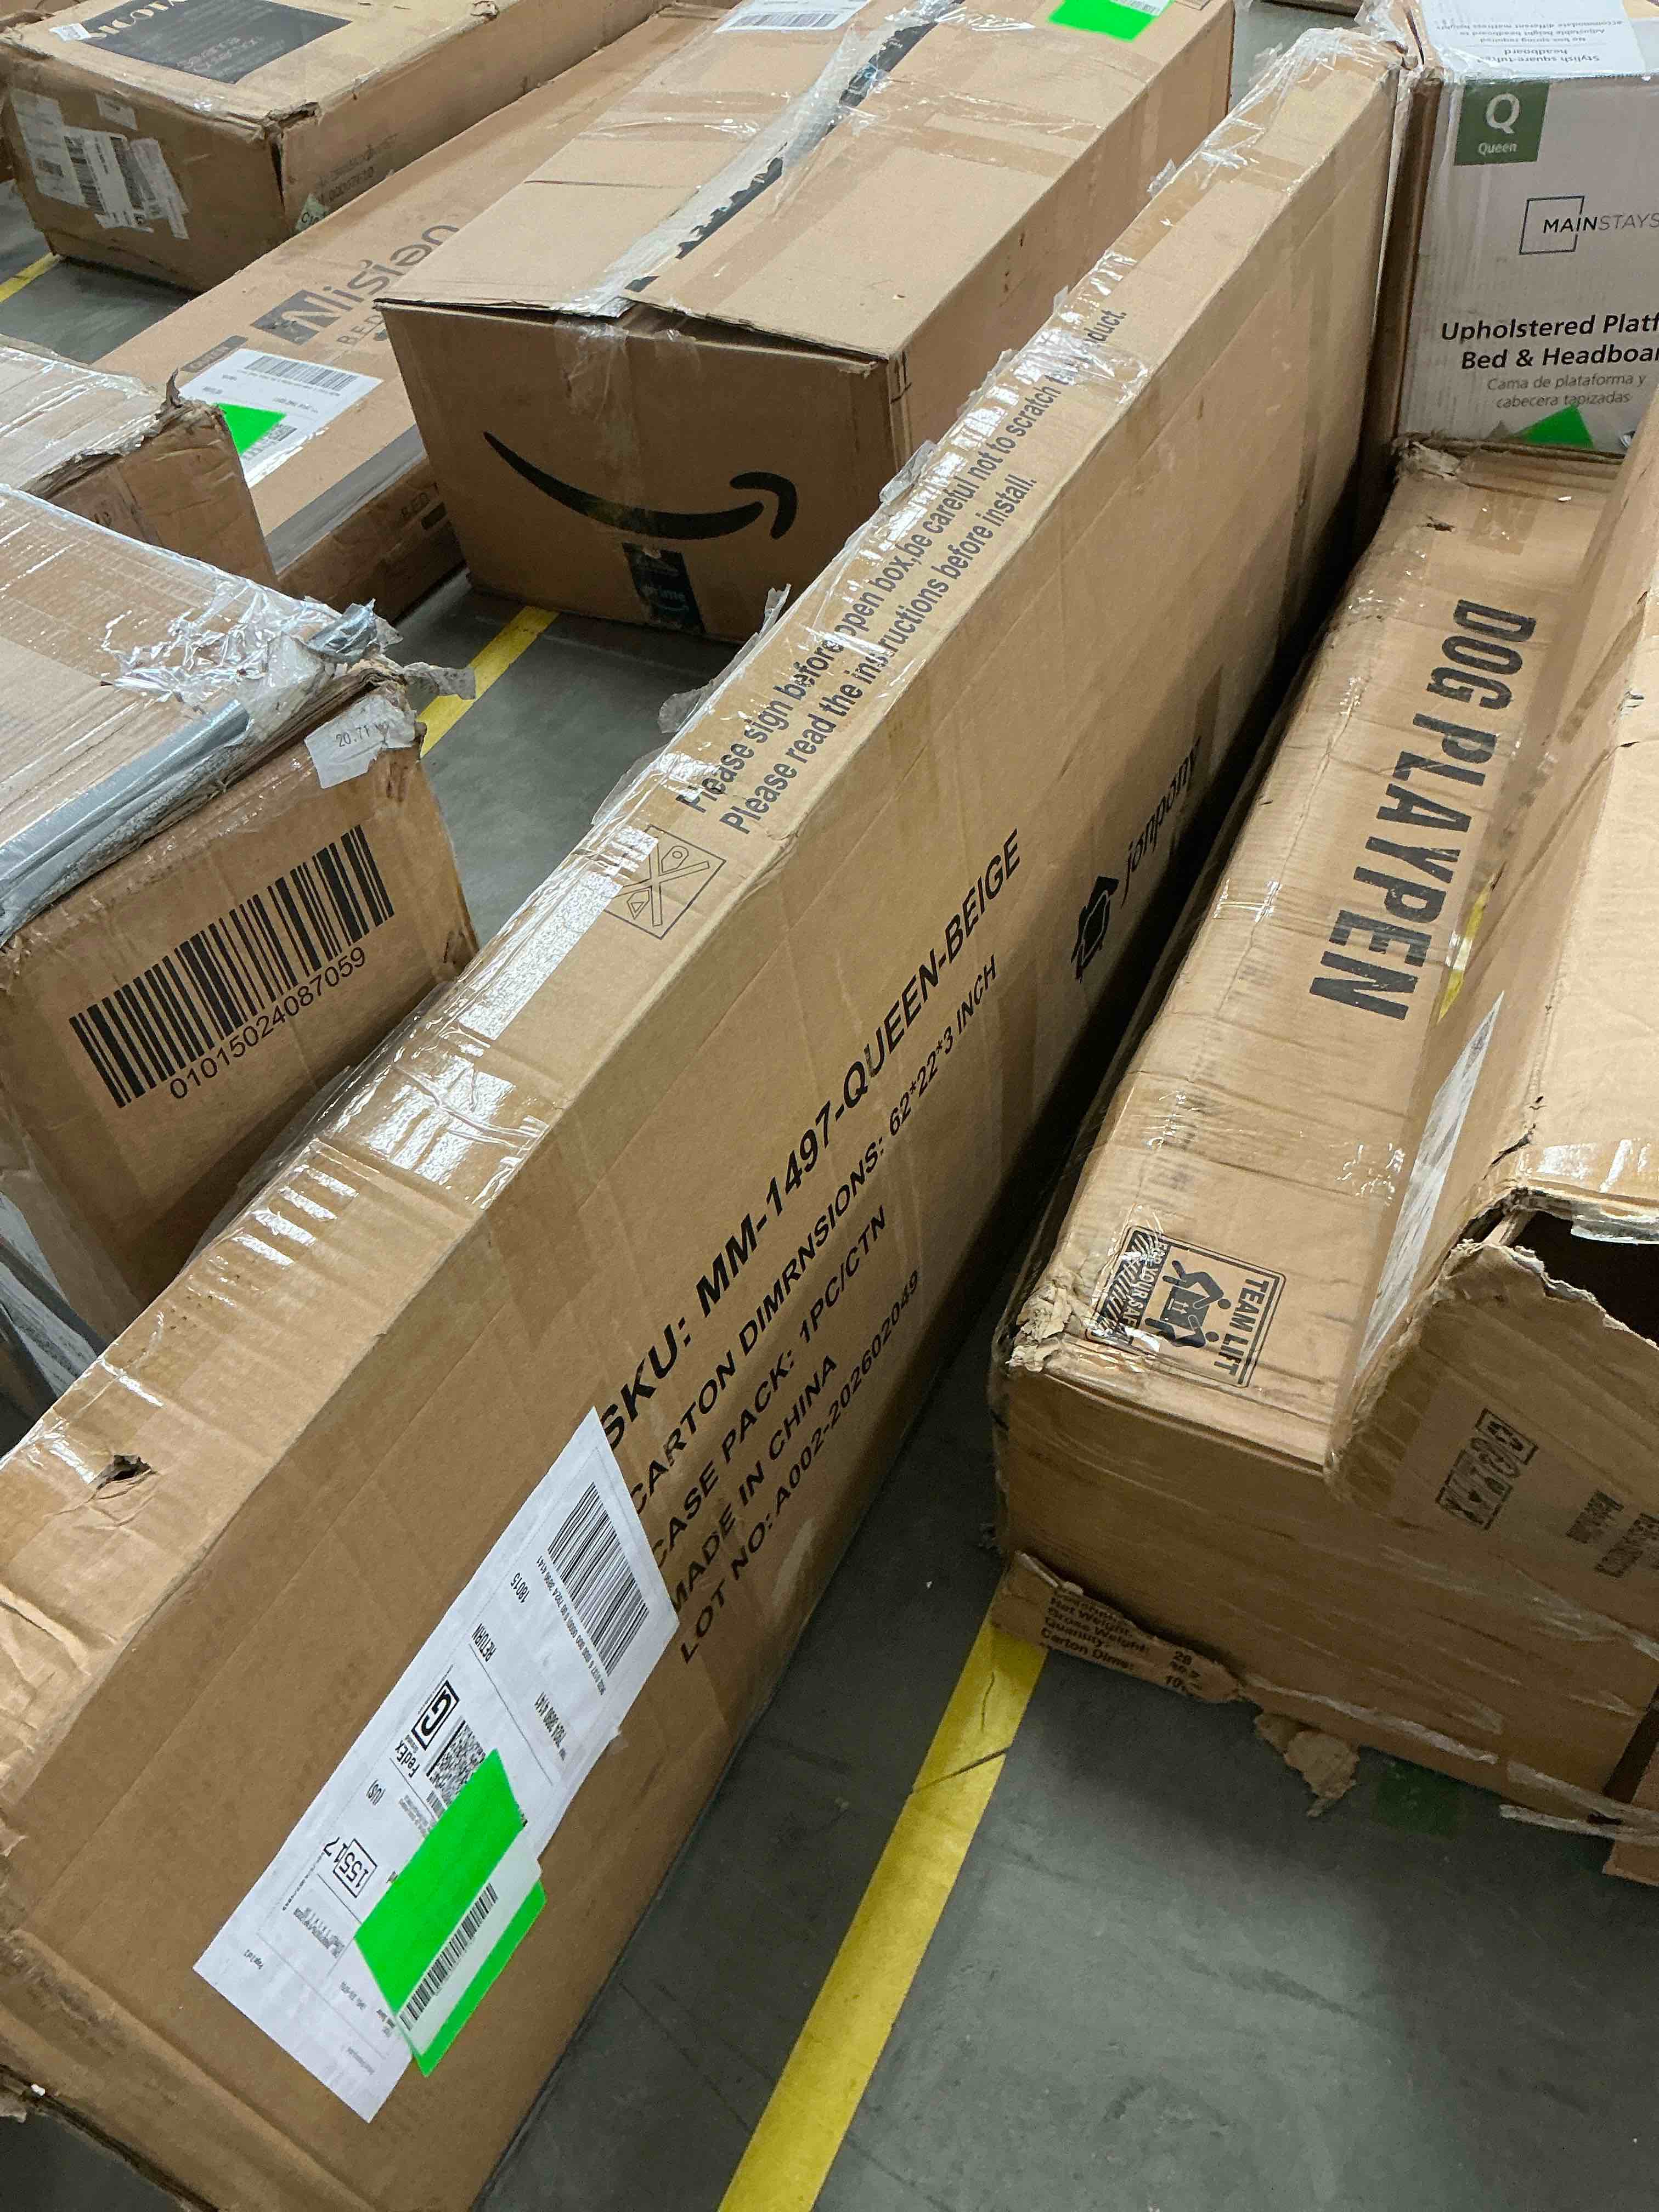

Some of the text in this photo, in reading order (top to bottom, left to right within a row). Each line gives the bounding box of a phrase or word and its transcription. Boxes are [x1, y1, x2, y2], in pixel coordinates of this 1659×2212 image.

[1486, 93, 1520, 134] Q
[1477, 142, 1518, 156] Queen
[1543, 212, 1659, 234] MAINSTAYS
[1441, 315, 1595, 344] Upholstered
[1462, 349, 1508, 369] Bed
[1516, 349, 1533, 367] &
[1488, 373, 1646, 395] Cama de plataforma y
[1496, 391, 1631, 409] cabecera tapizadas
[675, 743, 754, 813] Please
[744, 700, 794, 743] sign
[773, 640, 844, 701] before
[834, 588, 885, 637] open
[923, 475, 980, 534] careful
[968, 450, 1003, 481] not
[989, 437, 1016, 454] to
[1006, 384, 1063, 437] scratch
[720, 763, 797, 834] Please
[786, 713, 837, 764] read
[819, 684, 863, 718] the
[930, 525, 994, 580] before
[975, 473, 1037, 527] install.
[1427, 599, 1536, 710] DOG
[1310, 713, 1498, 1020] PLAYPEN
[170, 946, 366, 1099] 01015024087059
[600, 828, 1020, 1452] SKU: MM-1497-QUEEN-BEIGE
[630, 1350, 736, 1515] CARTON
[739, 1136, 884, 1356] DIMRNSIONS:
[957, 954, 997, 1035] INCH
[1132, 1265, 1159, 1299] YOUR
[722, 1349, 795, 1464] PACK:
[800, 1204, 885, 1344] 1PC/CTN
[1214, 1278, 1269, 1375] TEAM LIFT
[673, 1355, 838, 1612] MADE IN CHINA
[535, 1553, 549, 1576] 4141
[510, 1570, 531, 1606] 18015
[551, 1585, 565, 1609] 7924
[680, 1579, 726, 1664] LOT
[731, 1513, 774, 1581] NO:
[471, 1621, 496, 1662] RETURN
[1041, 1627, 1088, 1655] Carton
[417, 1688, 454, 1740] G
[392, 1738, 421, 1779] FedEx
[365, 1778, 386, 1807] (US)
[322, 1831, 369, 1890] 15517
